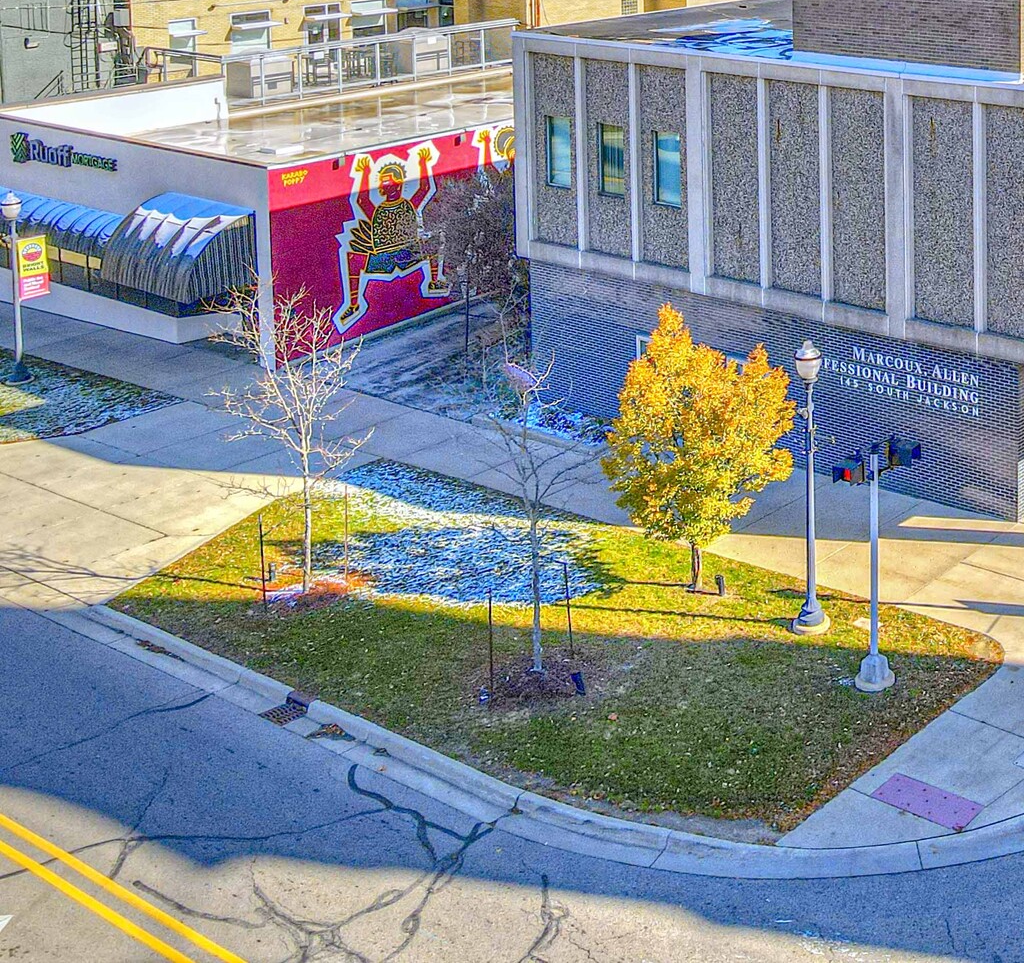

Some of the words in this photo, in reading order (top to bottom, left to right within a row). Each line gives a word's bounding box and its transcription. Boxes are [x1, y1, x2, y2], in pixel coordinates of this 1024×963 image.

[29, 139, 73, 167] Ruoff
[71, 152, 118, 172] MORTGAGE
[282, 170, 308, 181] KARABO
[283, 176, 305, 187] POPPY
[823, 358, 899, 386] FESSIONAL
[906, 375, 979, 404] BUILDING
[932, 364, 979, 387] ALLEN
[840, 376, 859, 388] 145
[868, 384, 910, 400] SOUTH
[917, 395, 979, 417] JACKSON
